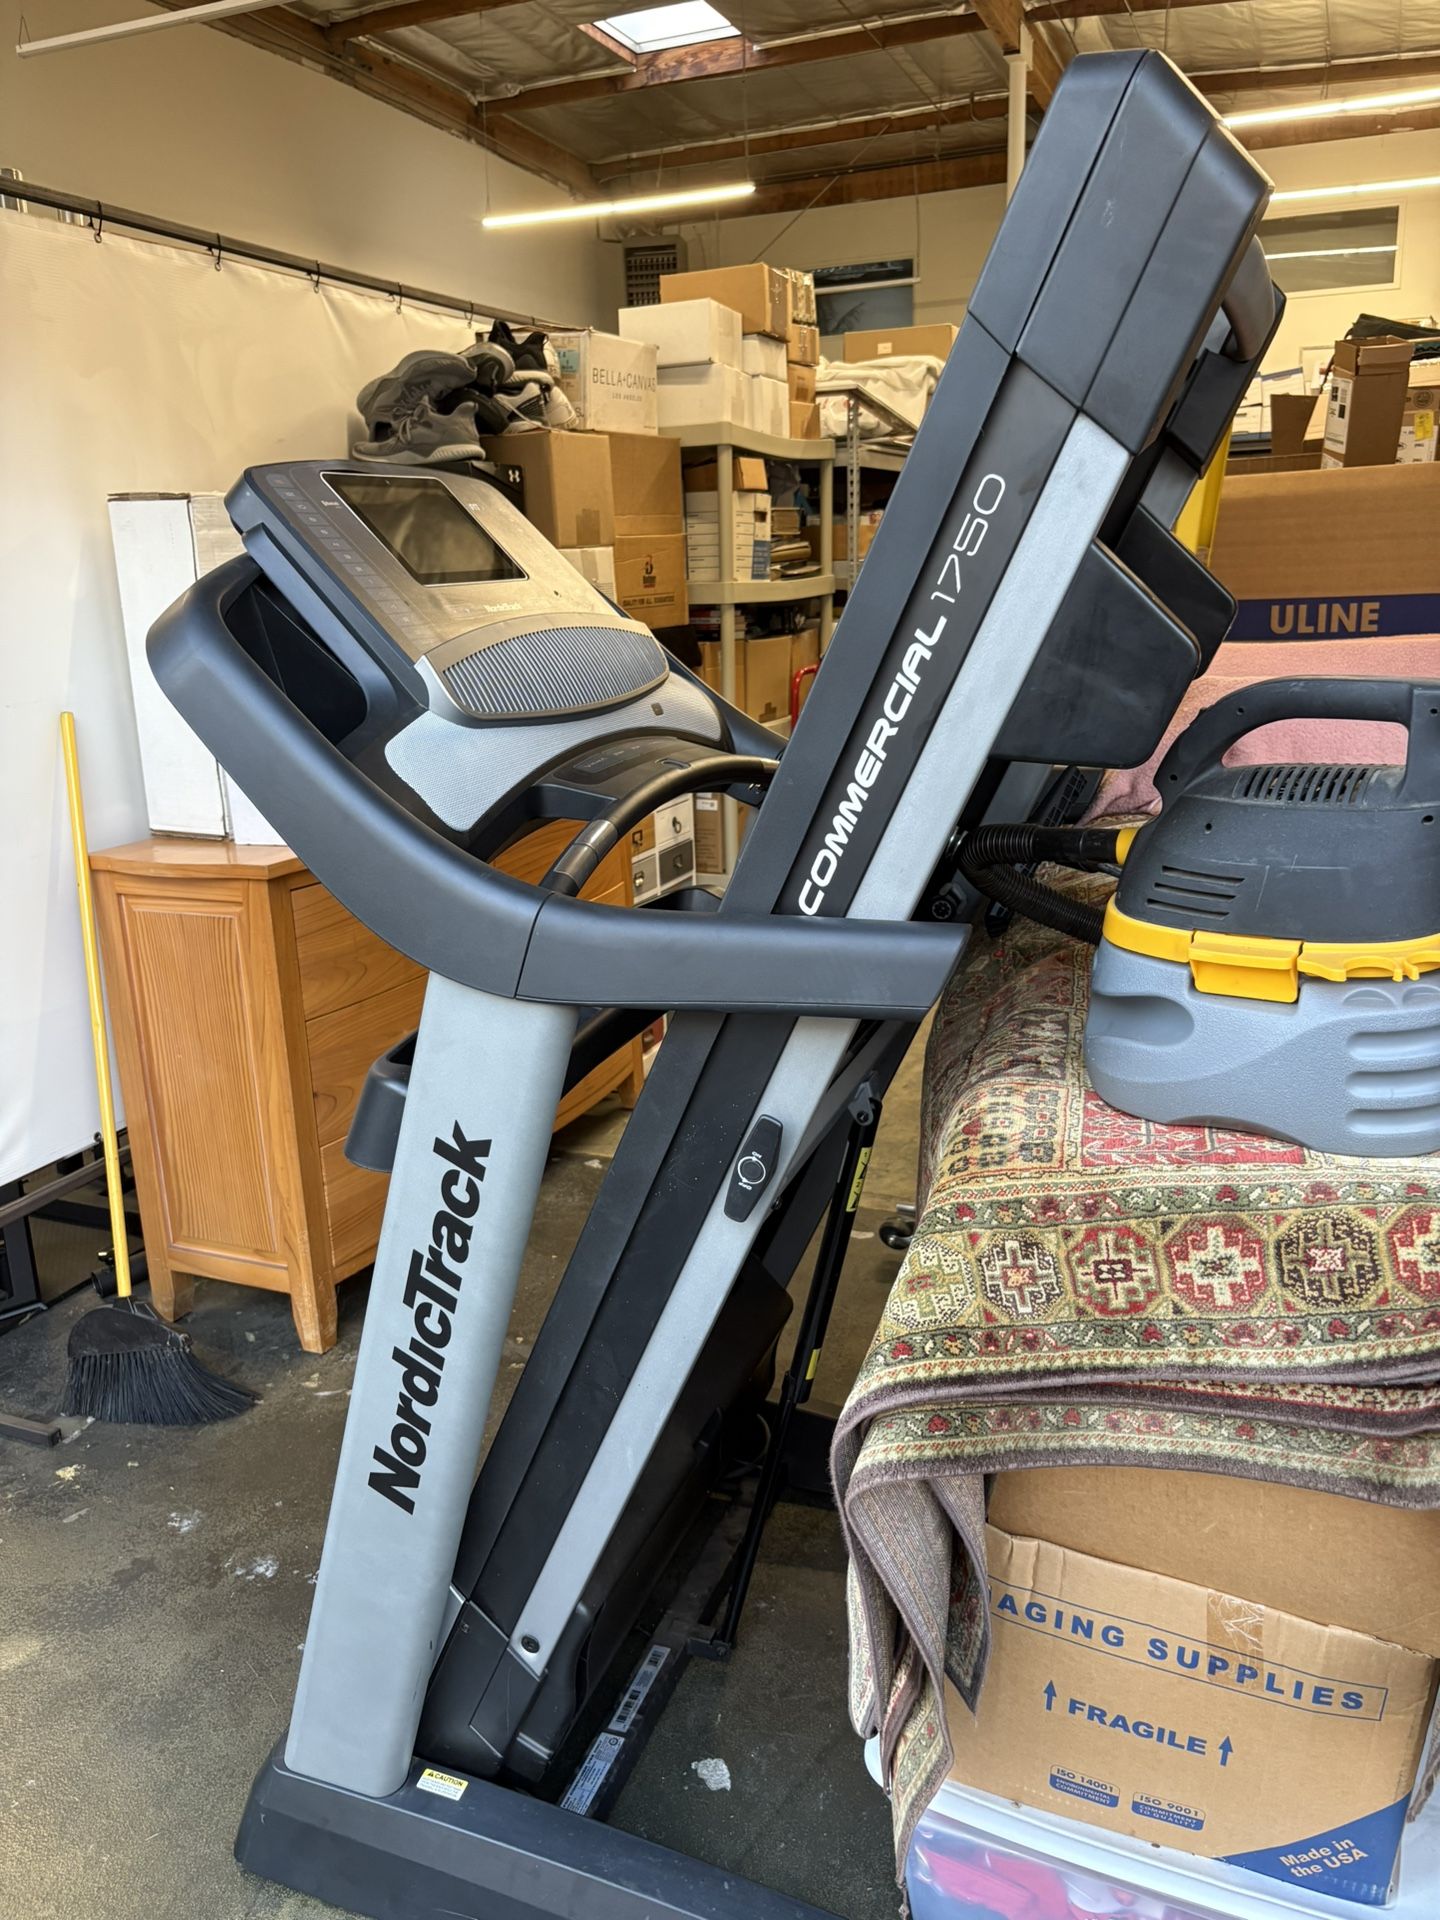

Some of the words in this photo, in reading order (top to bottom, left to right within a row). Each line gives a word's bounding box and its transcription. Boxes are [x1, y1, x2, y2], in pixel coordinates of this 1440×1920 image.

[931, 473, 1006, 603] 1750
[1270, 602, 1380, 635] ULINE
[798, 614, 947, 917] COMMERCIAL
[367, 1119, 493, 1516] NordicTrack
[987, 1587, 1125, 1648] AGING
[1147, 1637, 1364, 1710] SUPPLIES
[1067, 1697, 1208, 1756] FRAGILE
[434, 1772, 464, 1787] CAUTION
[1055, 1782, 1110, 1805] COMMITMENT
[1056, 1767, 1076, 1779] ISO
[1080, 1776, 1114, 1793] 14001
[1139, 1795, 1162, 1806] ISO
[1167, 1803, 1199, 1817] 9001
[1139, 1804, 1197, 1824] COMMITMENT
[1152, 1812, 1196, 1829] QUALITY
[1279, 1847, 1333, 1867] Made
[1331, 1839, 1356, 1851] in
[1290, 1864, 1324, 1878] the
[1323, 1848, 1369, 1868] USA
